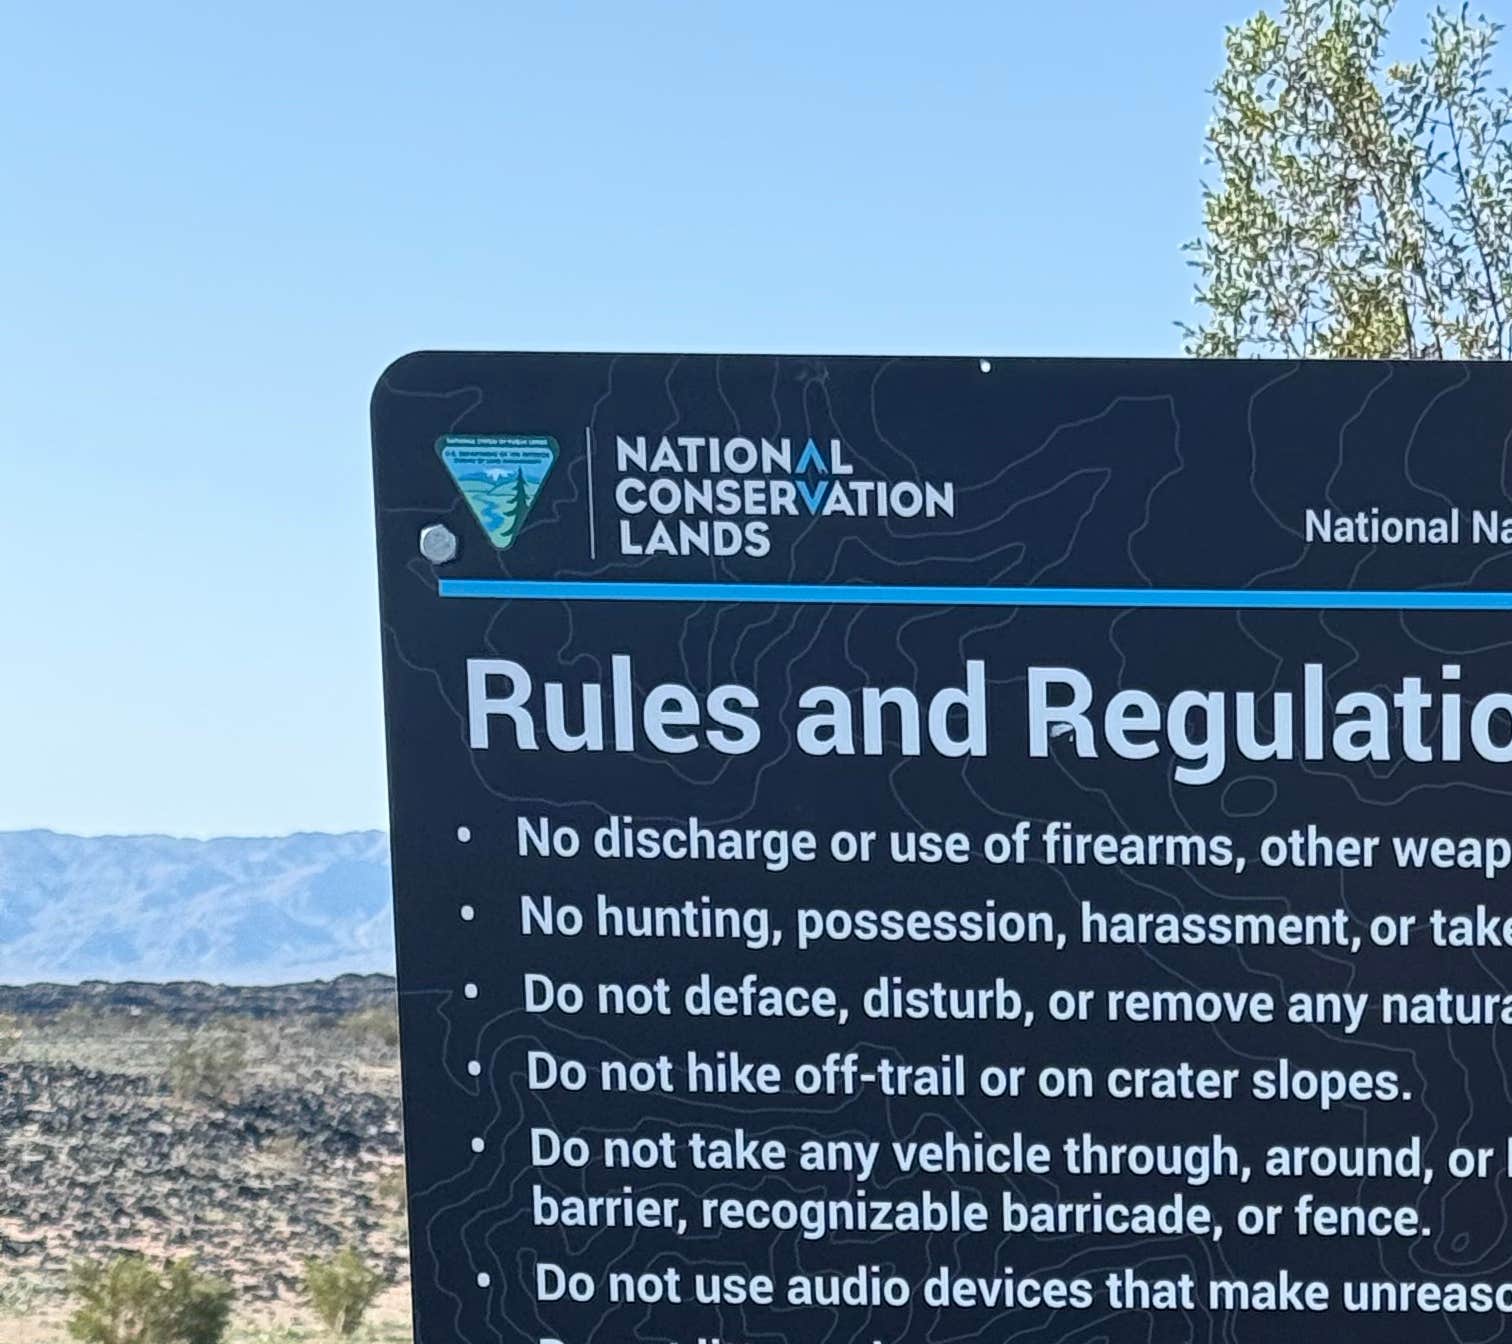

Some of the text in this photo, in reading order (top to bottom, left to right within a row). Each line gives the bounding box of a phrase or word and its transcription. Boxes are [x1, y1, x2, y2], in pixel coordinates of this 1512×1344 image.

[615, 435, 854, 475] NATIONAL
[614, 478, 955, 518] CONSERVATION
[619, 520, 771, 558] LANDS
[1305, 507, 1459, 544] National
[466, 653, 761, 755] Rules
[796, 659, 987, 758] and
[517, 816, 580, 858] No
[594, 815, 817, 872] discharge
[830, 830, 877, 862] or
[890, 831, 970, 863] use
[984, 820, 1031, 865] of
[1042, 820, 1246, 874] firearms,
[1260, 823, 1380, 868] other
[532, 1183, 1431, 1242] barrier, recognizable barricade, or fence.
